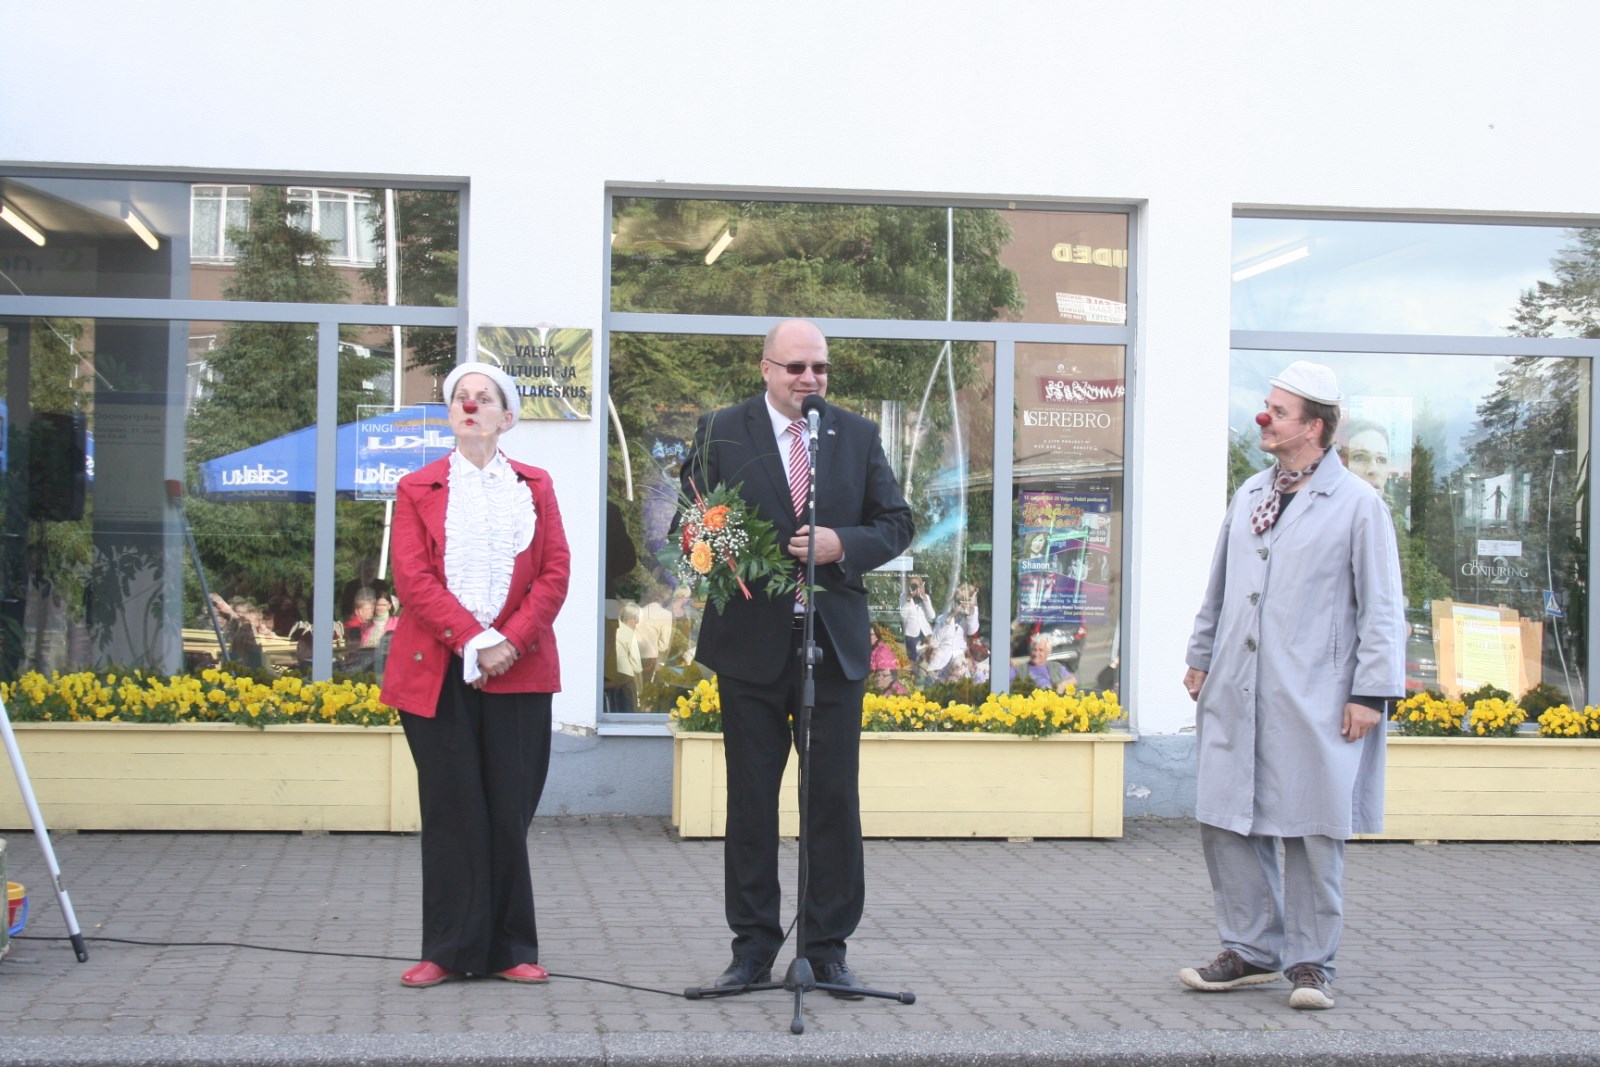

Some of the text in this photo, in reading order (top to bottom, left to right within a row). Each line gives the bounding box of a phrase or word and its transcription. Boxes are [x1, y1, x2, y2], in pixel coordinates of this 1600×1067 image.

[515, 345, 555, 358] VALGA
[560, 366, 577, 379] JA
[515, 385, 587, 399] ALAKESKUS
[1029, 411, 1111, 429] SEREBRO
[1022, 561, 1050, 570] Shanon
[1461, 562, 1529, 579] CONJURING
